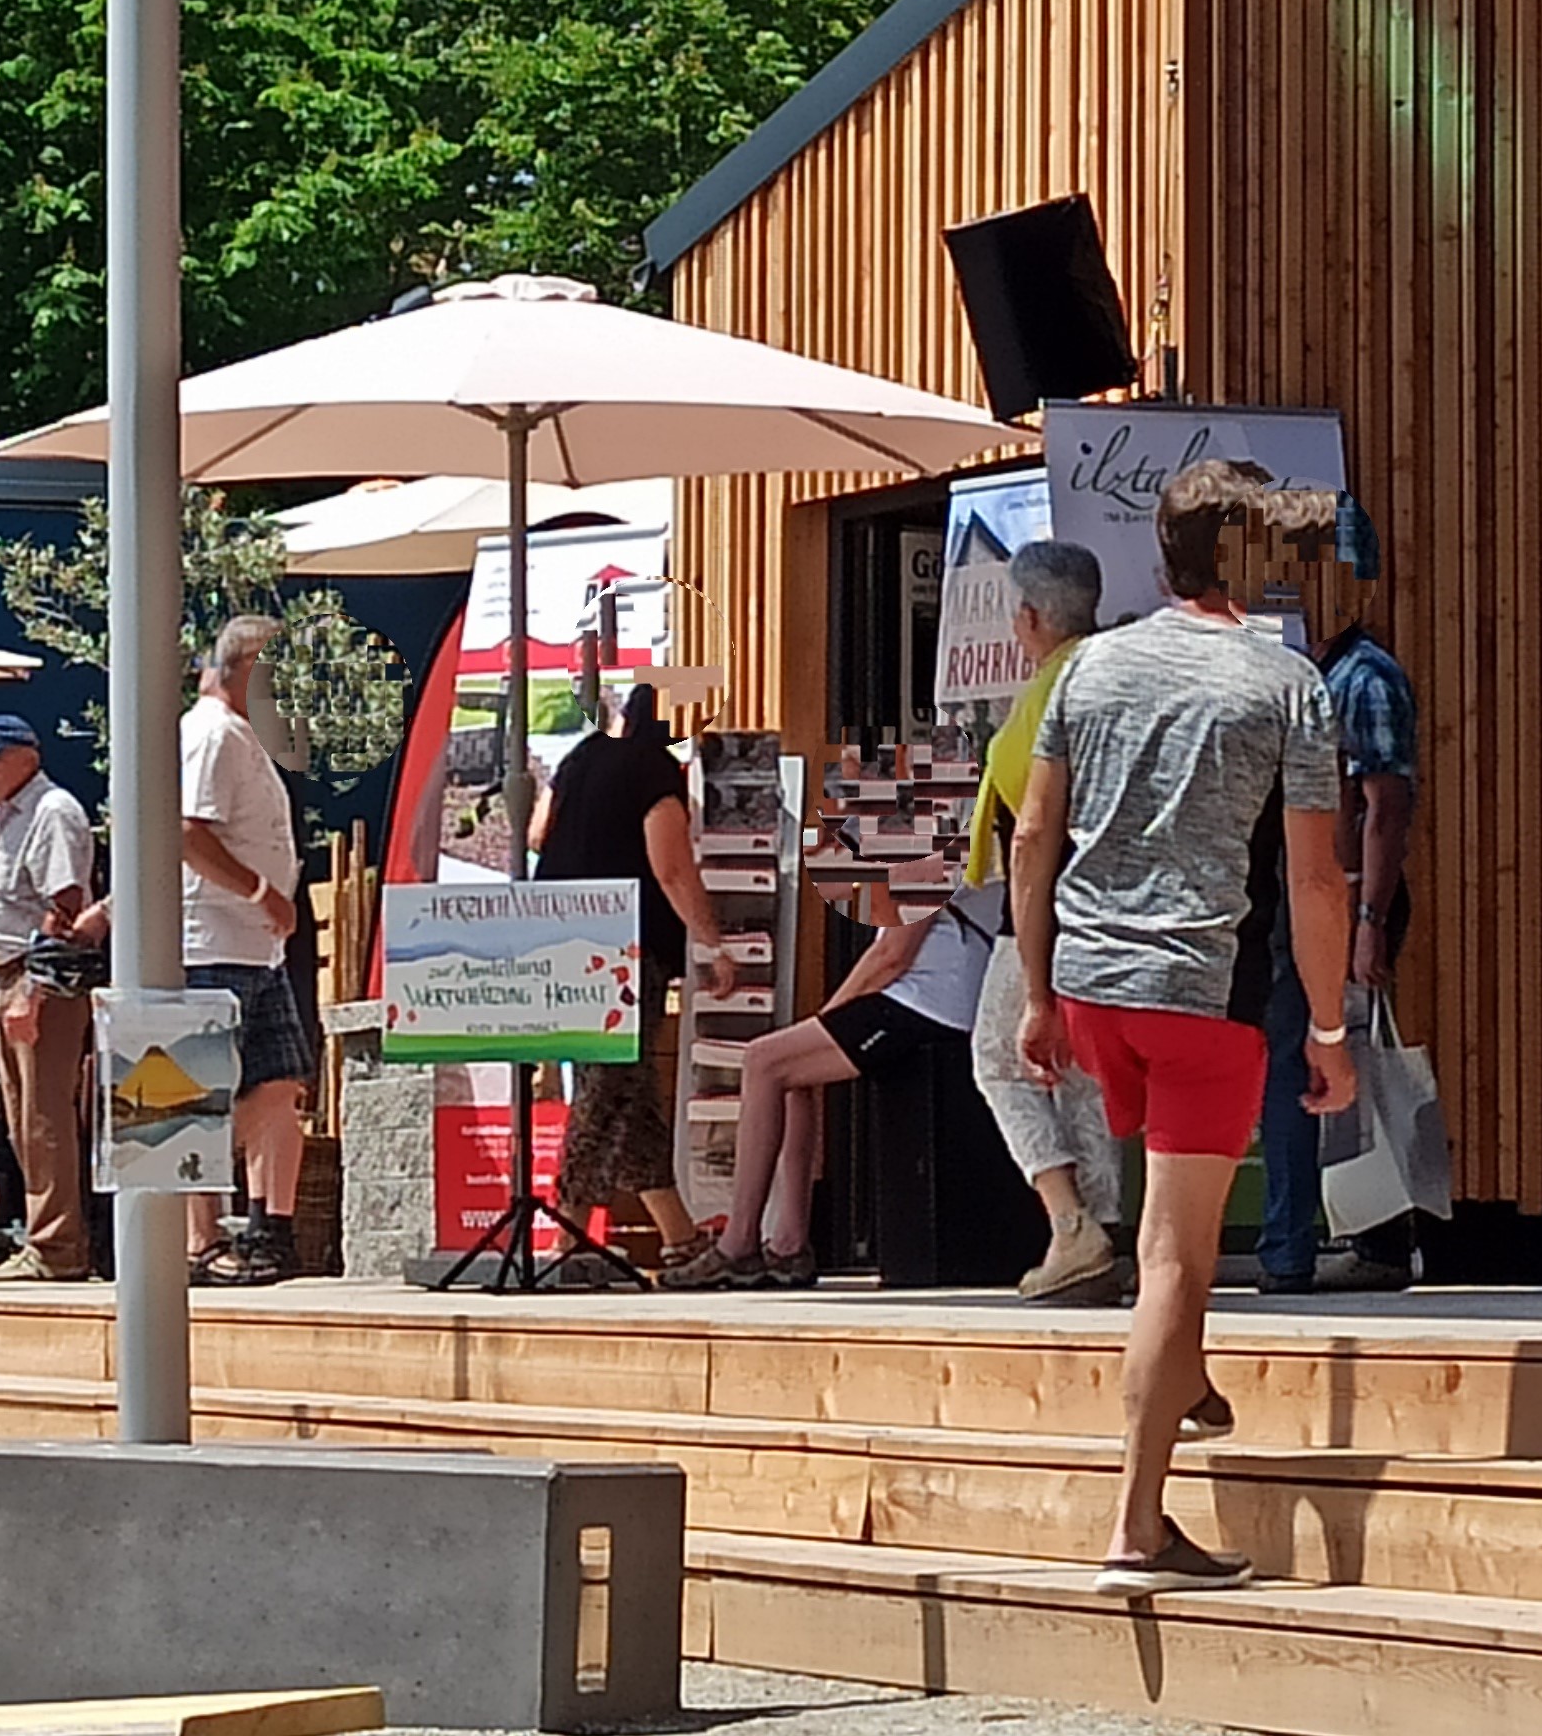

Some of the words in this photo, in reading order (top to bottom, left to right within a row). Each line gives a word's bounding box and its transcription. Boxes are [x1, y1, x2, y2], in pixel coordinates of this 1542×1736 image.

[947, 580, 1011, 625] MARK
[946, 637, 1039, 689] RÖHRNB
[509, 884, 629, 923] WILLKOMMEN
